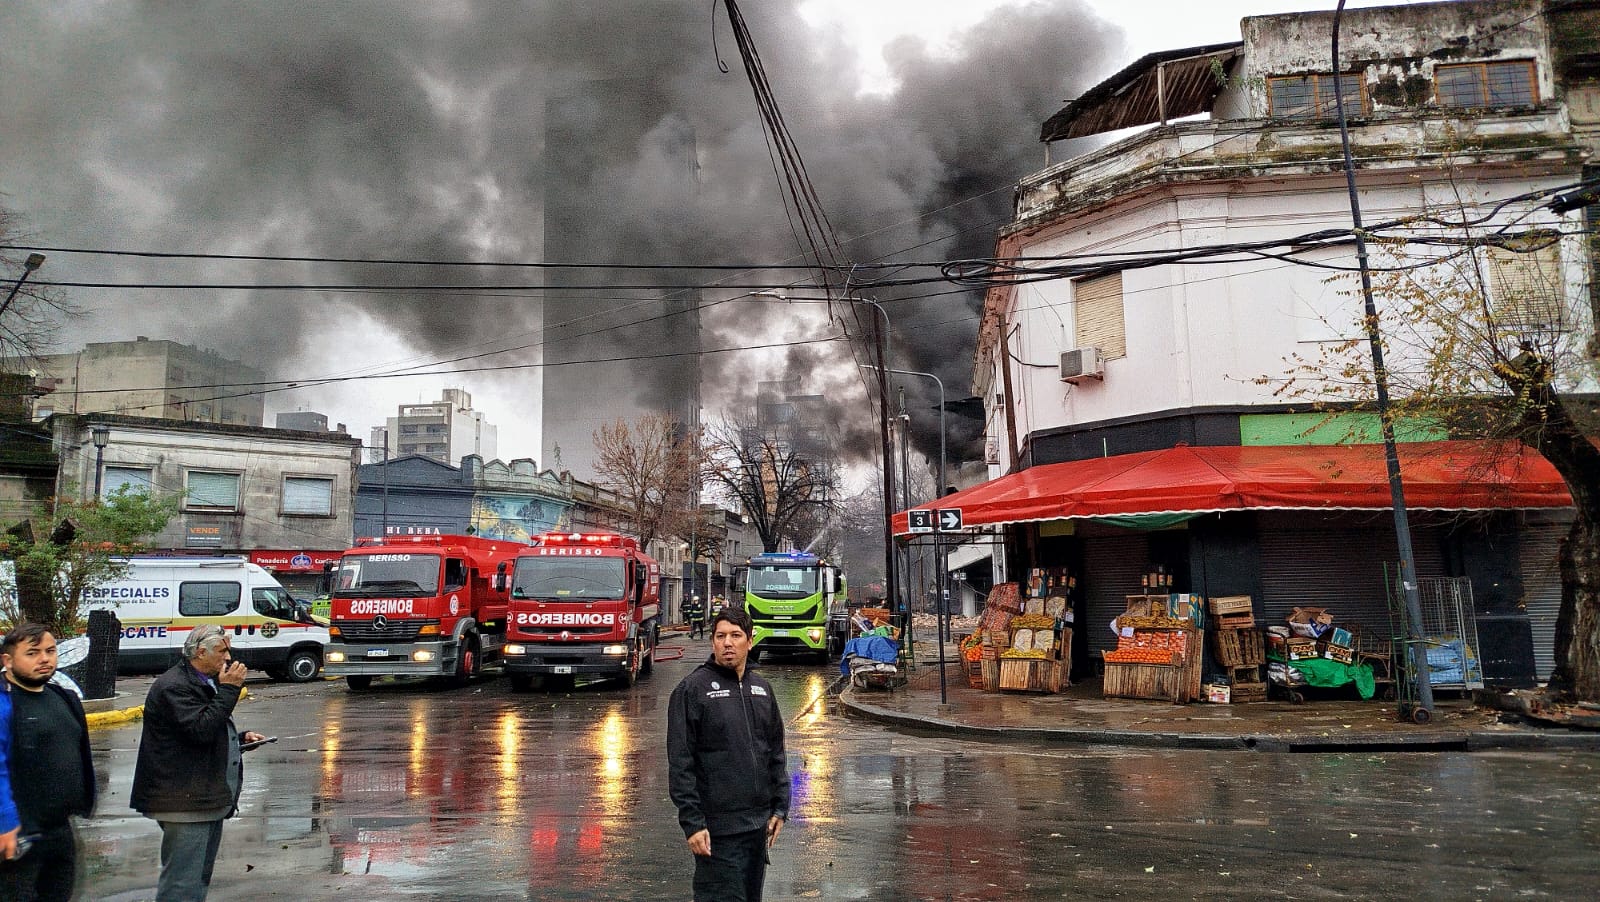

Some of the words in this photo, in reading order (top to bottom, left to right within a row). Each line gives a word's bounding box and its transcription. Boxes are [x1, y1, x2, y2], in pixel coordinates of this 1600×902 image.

[916, 516, 924, 526] 3
[540, 548, 603, 556] BERISSO
[368, 554, 411, 562] BERISSO
[83, 587, 170, 598] ESPECIALES
[119, 626, 167, 638] SCATE
